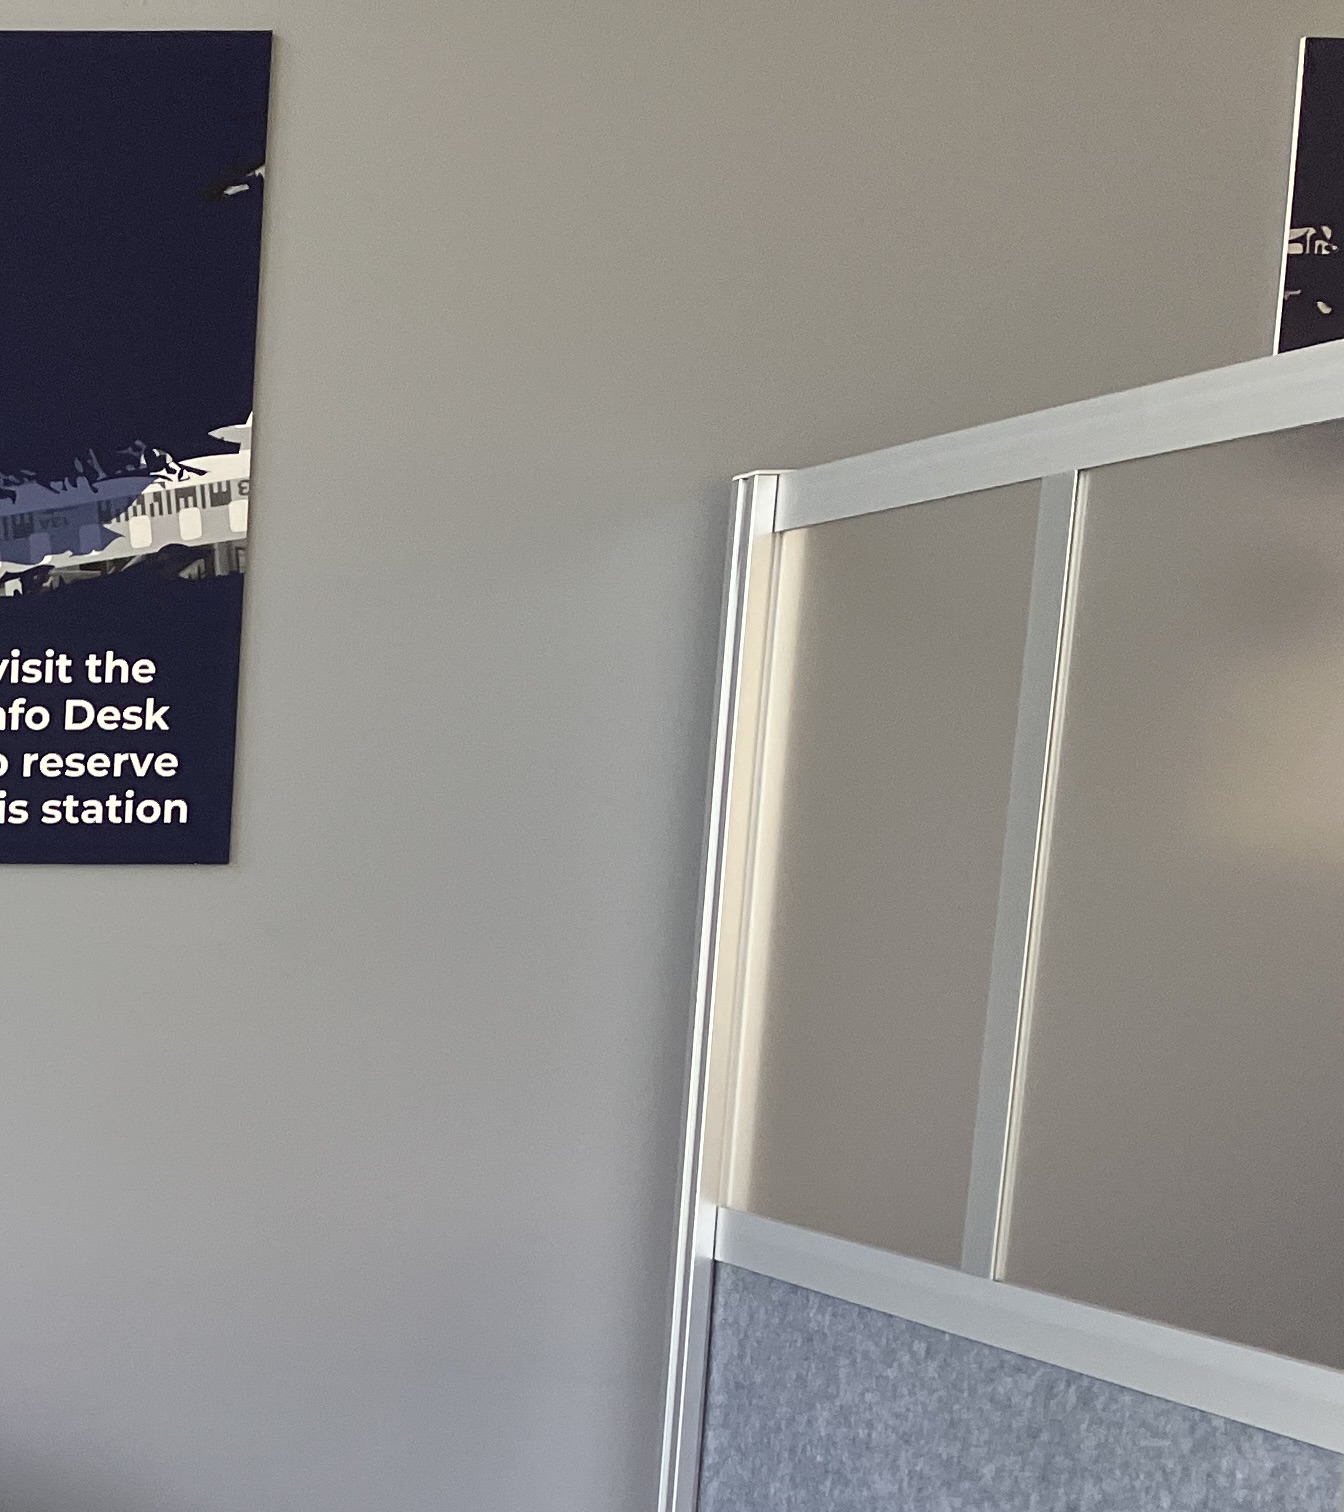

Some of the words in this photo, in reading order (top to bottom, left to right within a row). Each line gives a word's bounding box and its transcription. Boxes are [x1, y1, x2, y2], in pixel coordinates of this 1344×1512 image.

[84, 650, 156, 684] the
[64, 697, 170, 731] Desk
[22, 752, 179, 778] reserve
[40, 789, 188, 824] station
